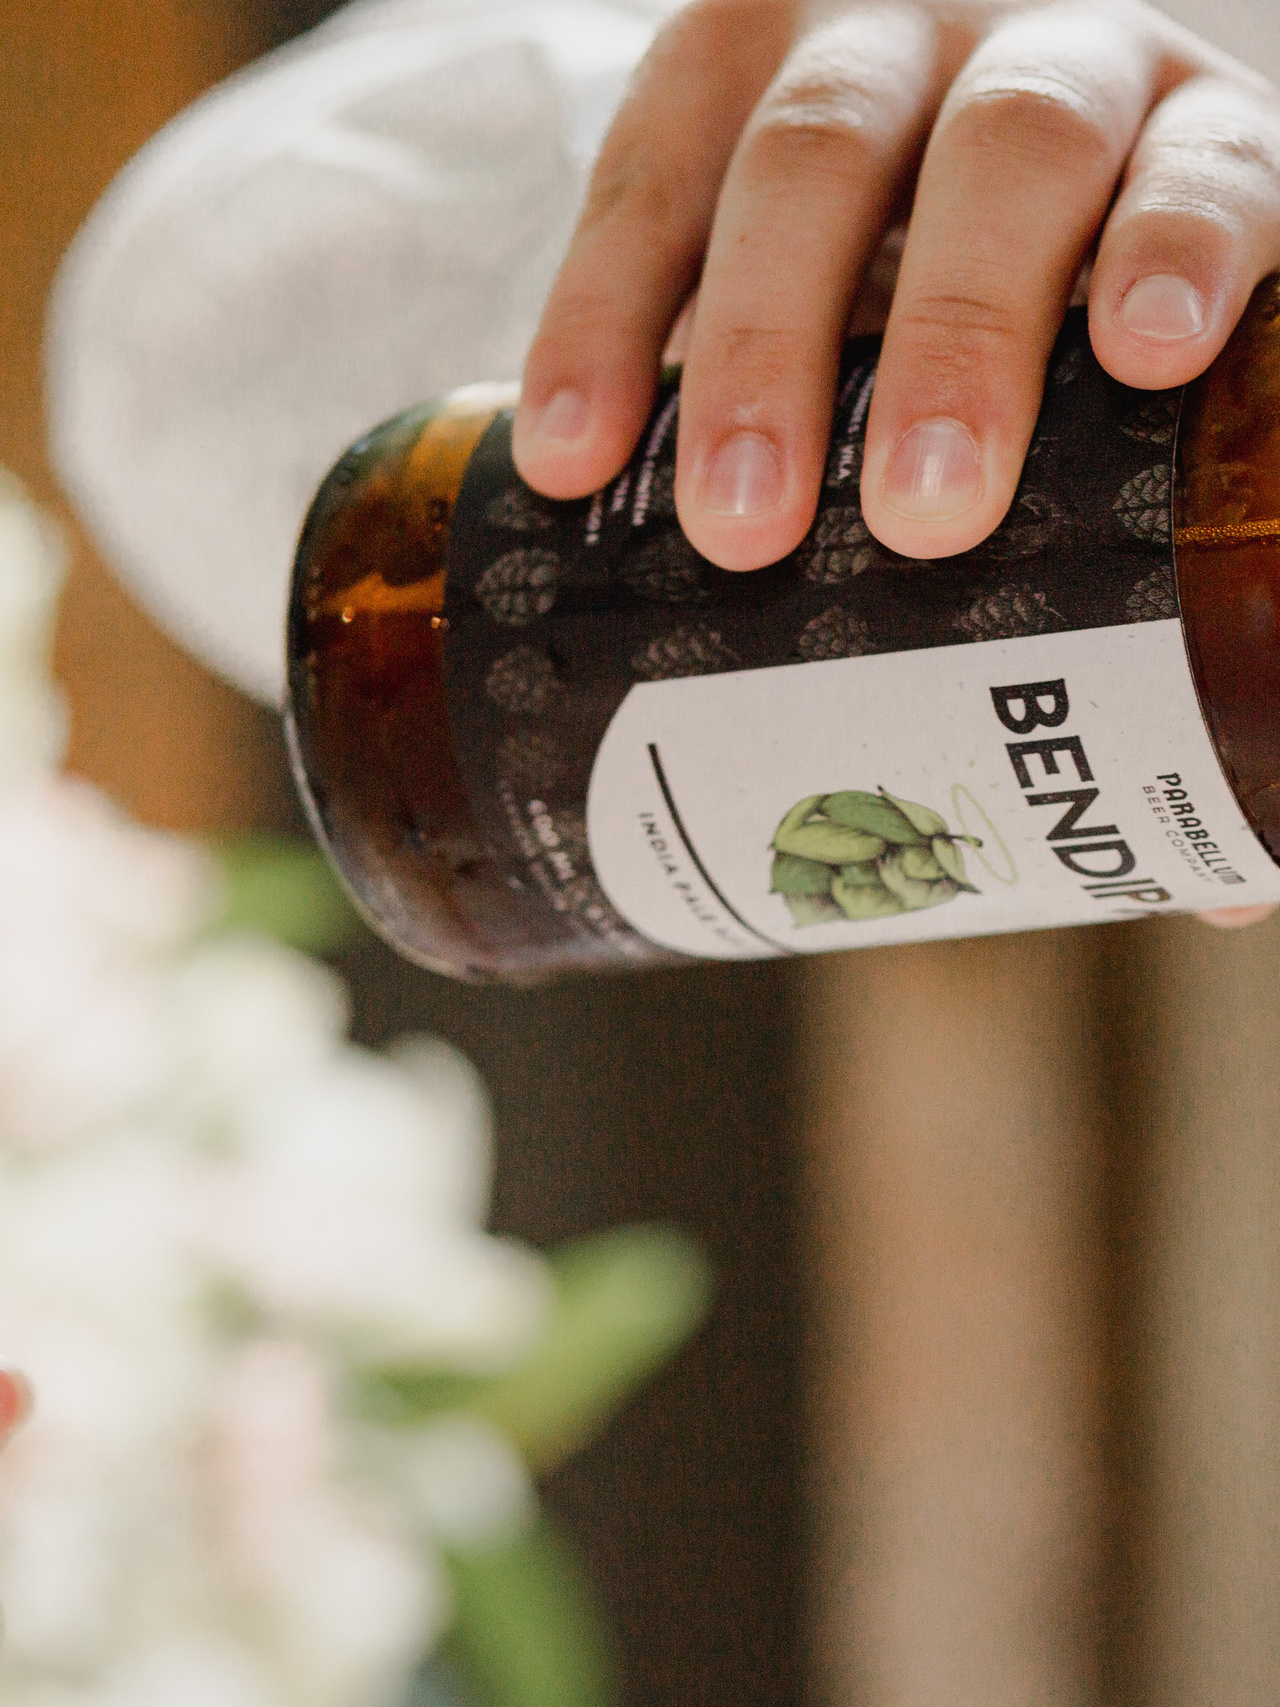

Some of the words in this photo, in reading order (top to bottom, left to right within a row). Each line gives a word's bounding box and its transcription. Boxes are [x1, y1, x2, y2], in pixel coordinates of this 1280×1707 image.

[989, 677, 1173, 916] BENDIP
[1142, 785, 1170, 824] BEER
[1156, 772, 1247, 885] PARABELLUM
[638, 812, 678, 876] INDIA
